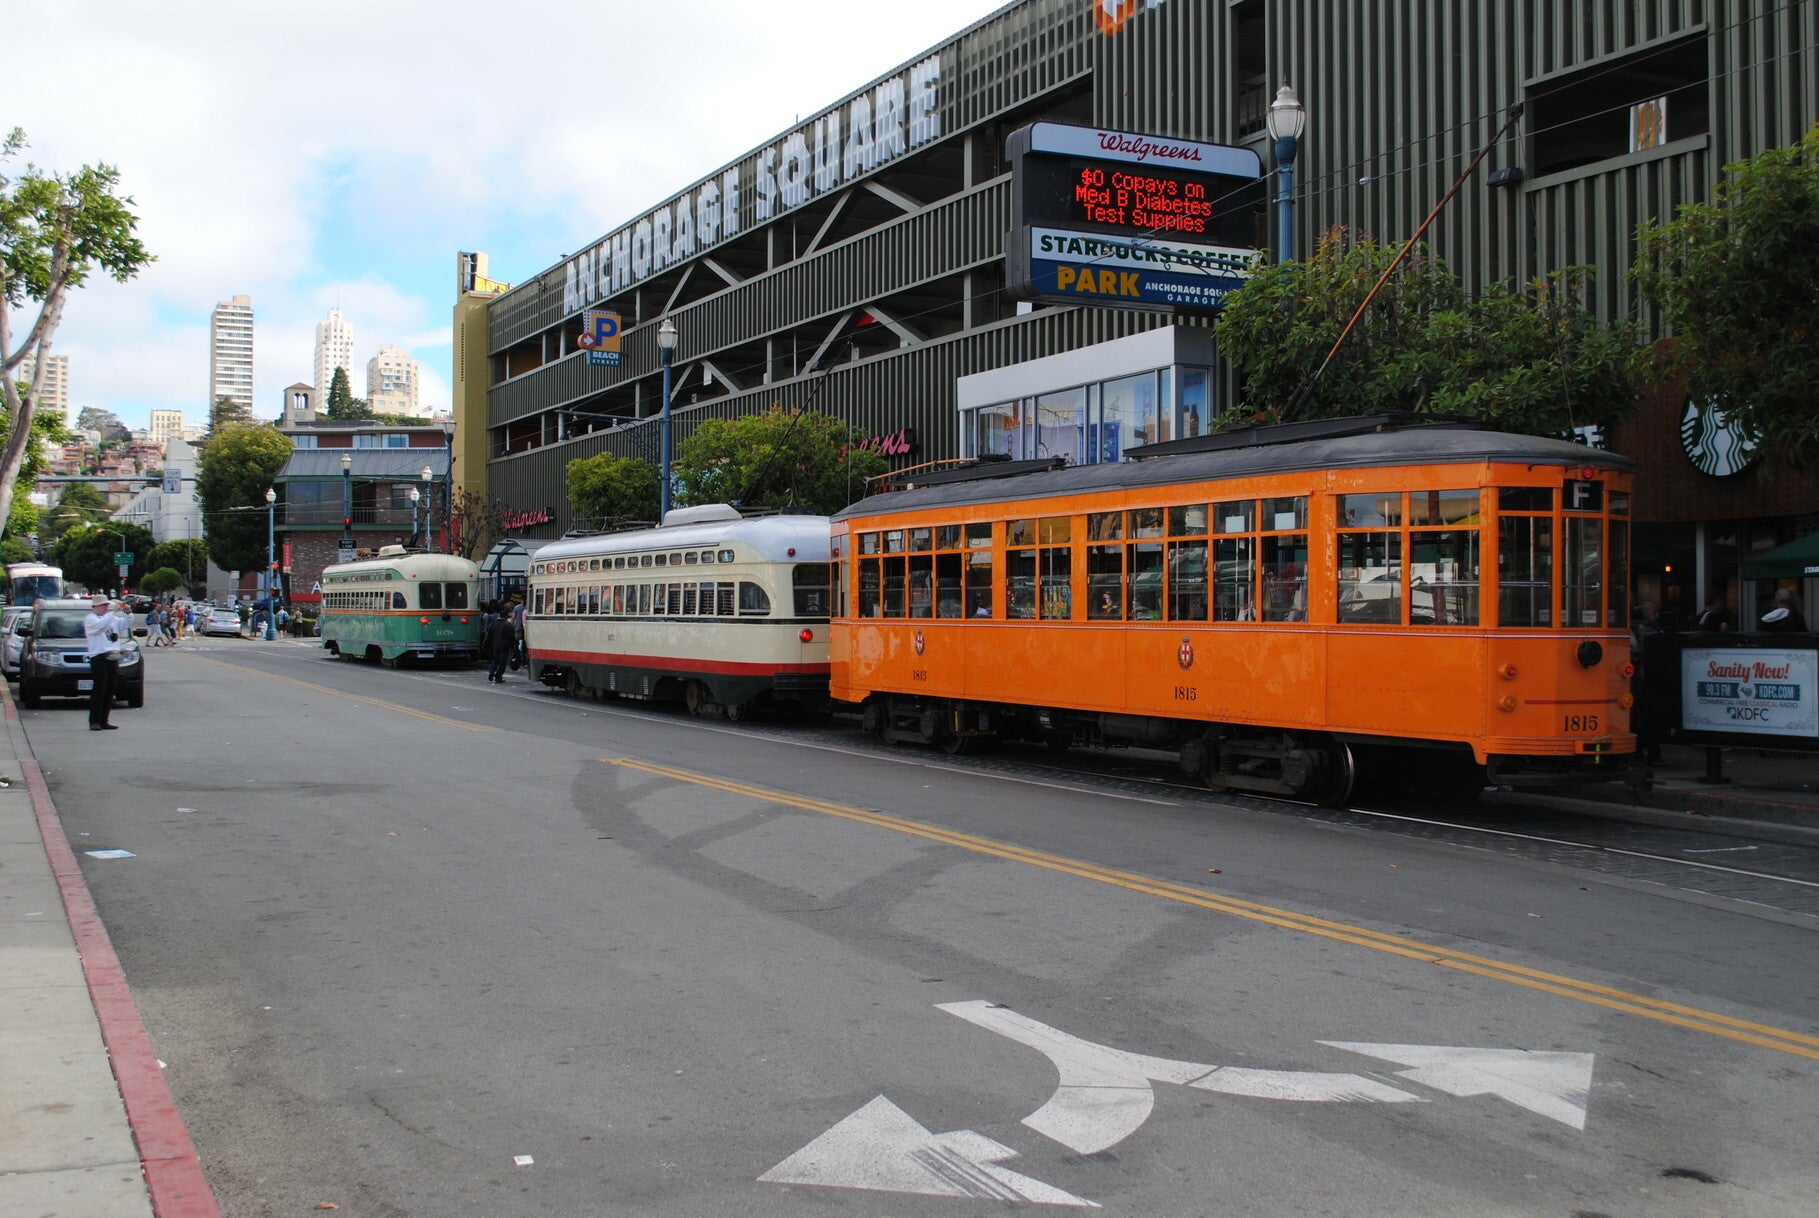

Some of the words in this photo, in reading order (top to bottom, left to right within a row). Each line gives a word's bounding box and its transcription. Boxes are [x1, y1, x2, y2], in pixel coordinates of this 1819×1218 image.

[1097, 132, 1202, 161] Walgreens
[563, 166, 740, 316] ANCHORAGE
[756, 54, 941, 221] SQUARE
[1111, 171, 1178, 196] Copays
[1184, 183, 1206, 198] on
[1075, 184, 1110, 205] Med
[1117, 189, 1129, 207] B
[1136, 191, 1213, 217] Diabetes
[1083, 203, 1126, 224] Test
[1132, 208, 1206, 233] Supplies
[1057, 265, 1141, 297] PARK
[1144, 281, 1201, 296] ANCHORAGE
[1167, 293, 1216, 306] GARAGE
[596, 317, 618, 347] P
[592, 350, 619, 360] BEACH
[1573, 482, 1591, 508] F
[912, 668, 928, 682] 1815
[1707, 660, 1751, 684] Sanity
[1752, 661, 1790, 680] Now!
[1173, 685, 1198, 701] 1815
[1759, 686, 1795, 699] KDFC.COM
[1563, 714, 1599, 733] 1815
[1736, 707, 1770, 722] KDFC
